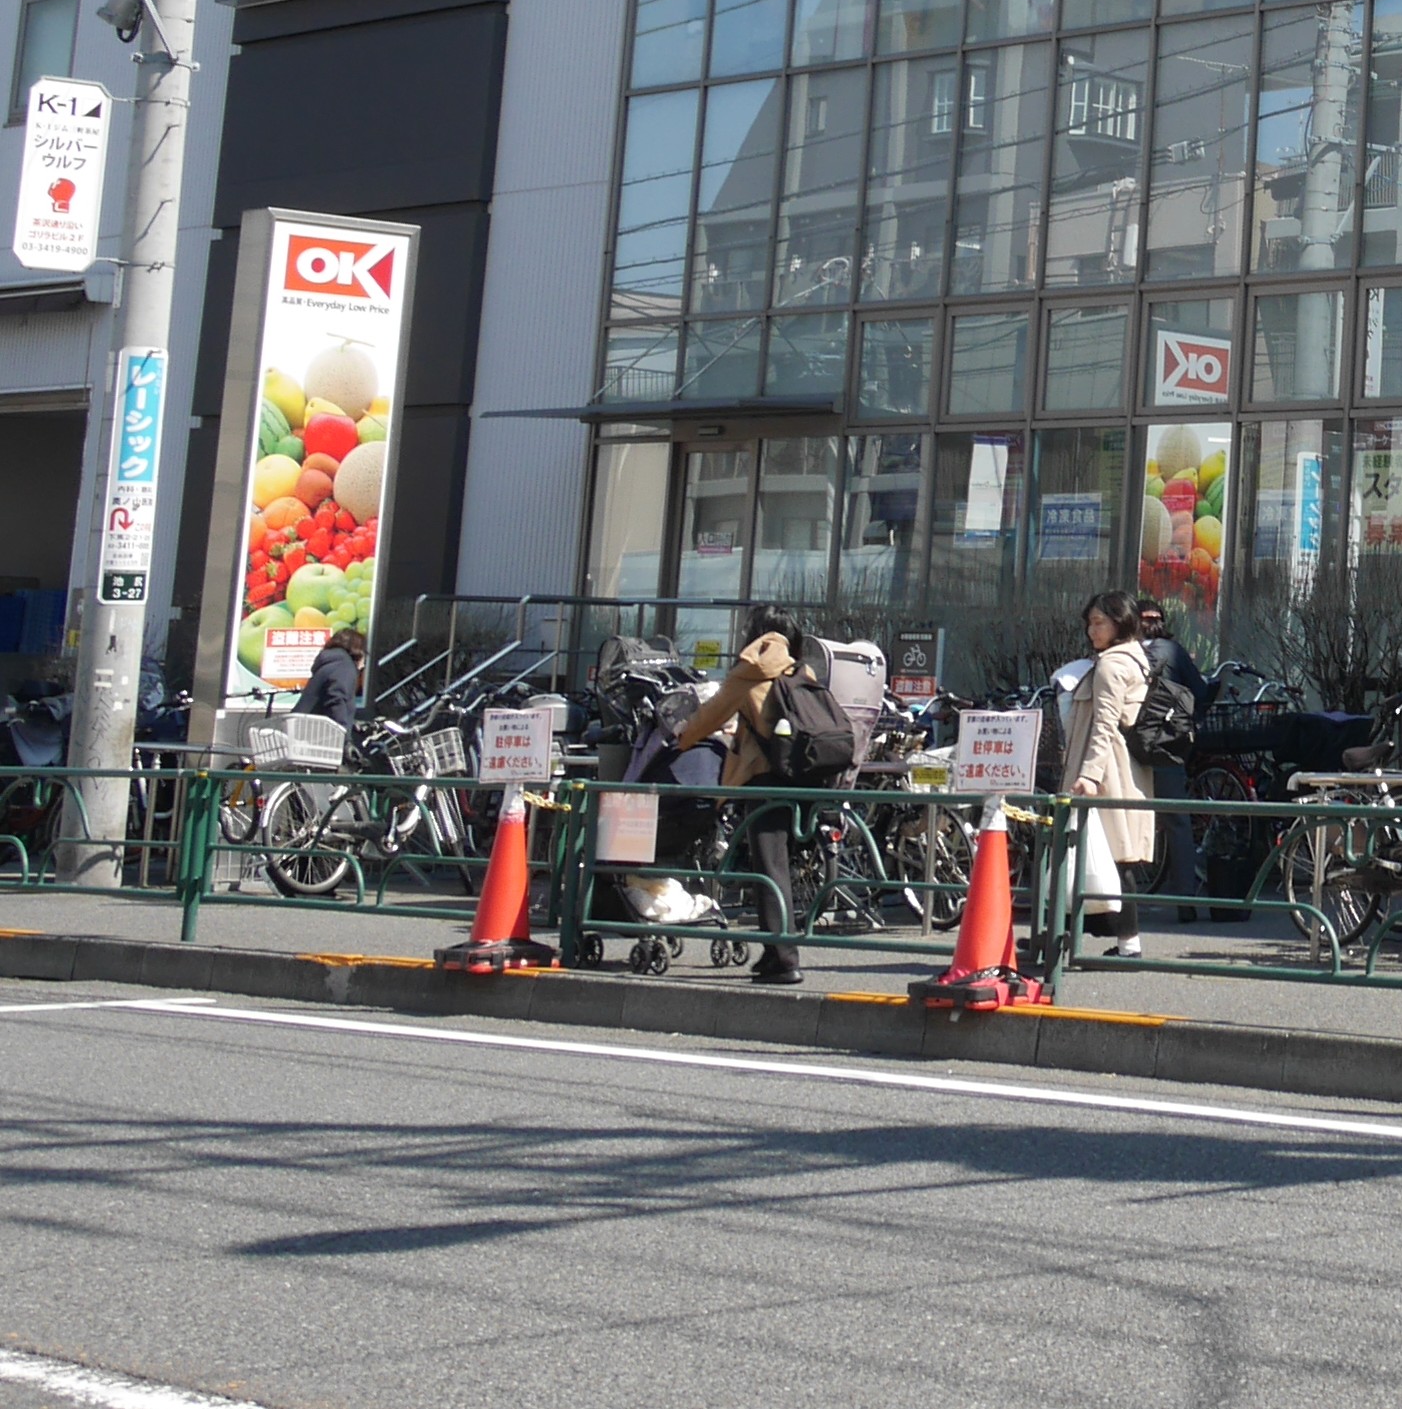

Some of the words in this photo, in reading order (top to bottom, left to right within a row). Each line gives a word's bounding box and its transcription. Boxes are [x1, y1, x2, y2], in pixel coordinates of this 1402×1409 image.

[37, 93, 77, 116] K-1
[34, 134, 99, 153] シルバー
[41, 153, 87, 171] ウルフ
[295, 240, 393, 298] OK
[348, 303, 367, 313] Low
[369, 304, 390, 315] Price
[121, 365, 157, 479] レーシック
[112, 588, 142, 599] 3-27
[972, 740, 1014, 755] 駐停車は
